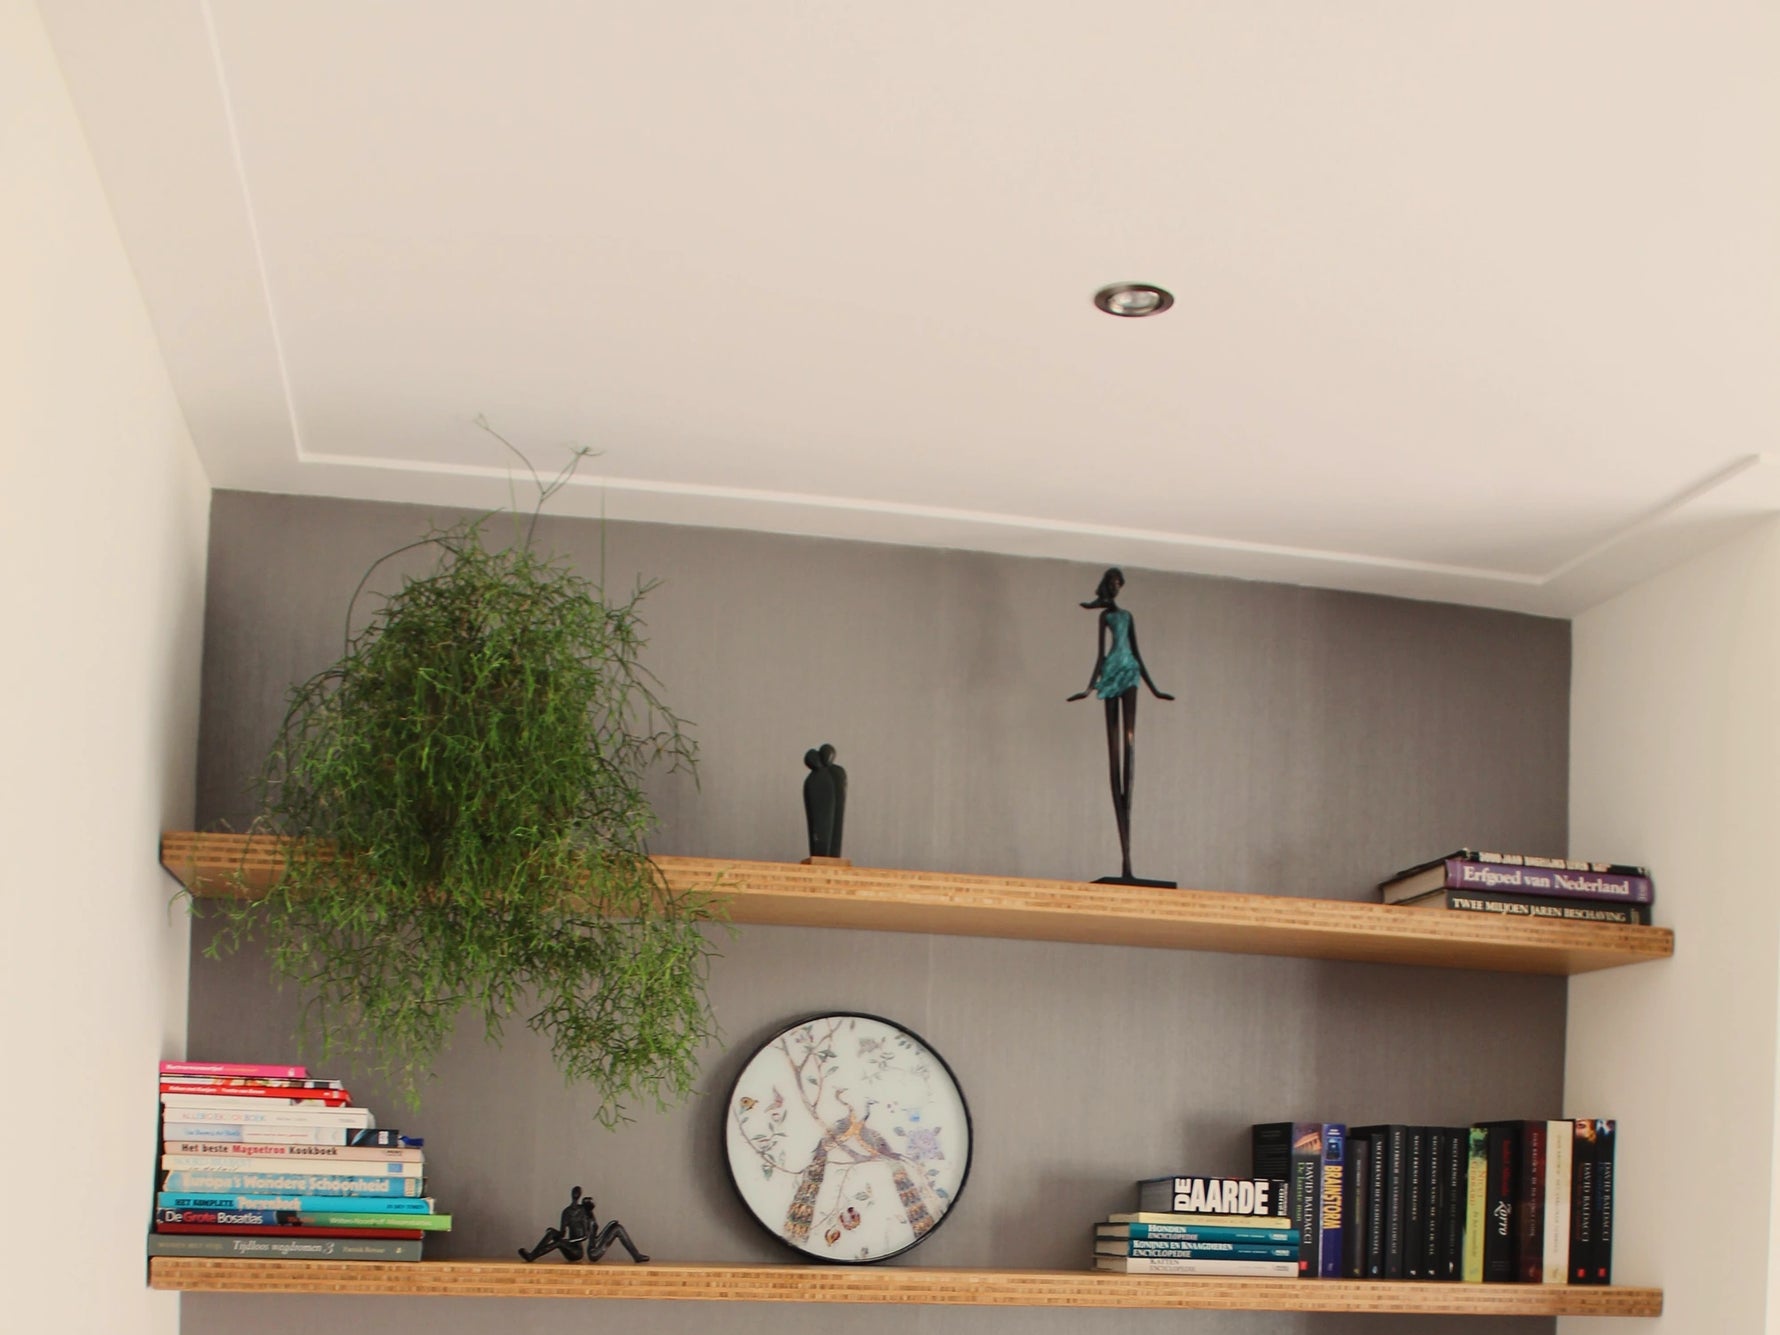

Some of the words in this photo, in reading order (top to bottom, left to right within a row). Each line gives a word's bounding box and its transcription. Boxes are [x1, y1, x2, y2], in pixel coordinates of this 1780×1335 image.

[1463, 865, 1521, 886] Erfgoed
[1524, 876, 1549, 888] van
[1554, 875, 1629, 895] Nederland
[1452, 897, 1481, 909] TWEE
[1485, 901, 1528, 915] MILJOEN
[1530, 904, 1562, 917] JAREN
[1563, 907, 1626, 922] BESCHAVING
[181, 1144, 199, 1153] Het
[202, 1144, 228, 1154] beste
[232, 1144, 286, 1157] Magnetron
[288, 1146, 338, 1156] Kookboek
[1305, 1162, 1313, 1193] DAVID
[1584, 1162, 1592, 1193] DAVID
[1603, 1162, 1612, 1192] DAVID
[1174, 1178, 1191, 1211] DE
[1190, 1178, 1269, 1215] AARDE
[1323, 1165, 1342, 1230] BRAINSTORM
[165, 1211, 182, 1223] De
[182, 1212, 217, 1224] Grote
[217, 1212, 263, 1225] Bosatlas
[1148, 1224, 1187, 1233] HONDEN
[1304, 1196, 1312, 1245] BALDACCI
[1495, 1201, 1512, 1236] Zorro
[1582, 1195, 1591, 1243] BALDACCI
[1602, 1194, 1611, 1242] BALDACCI
